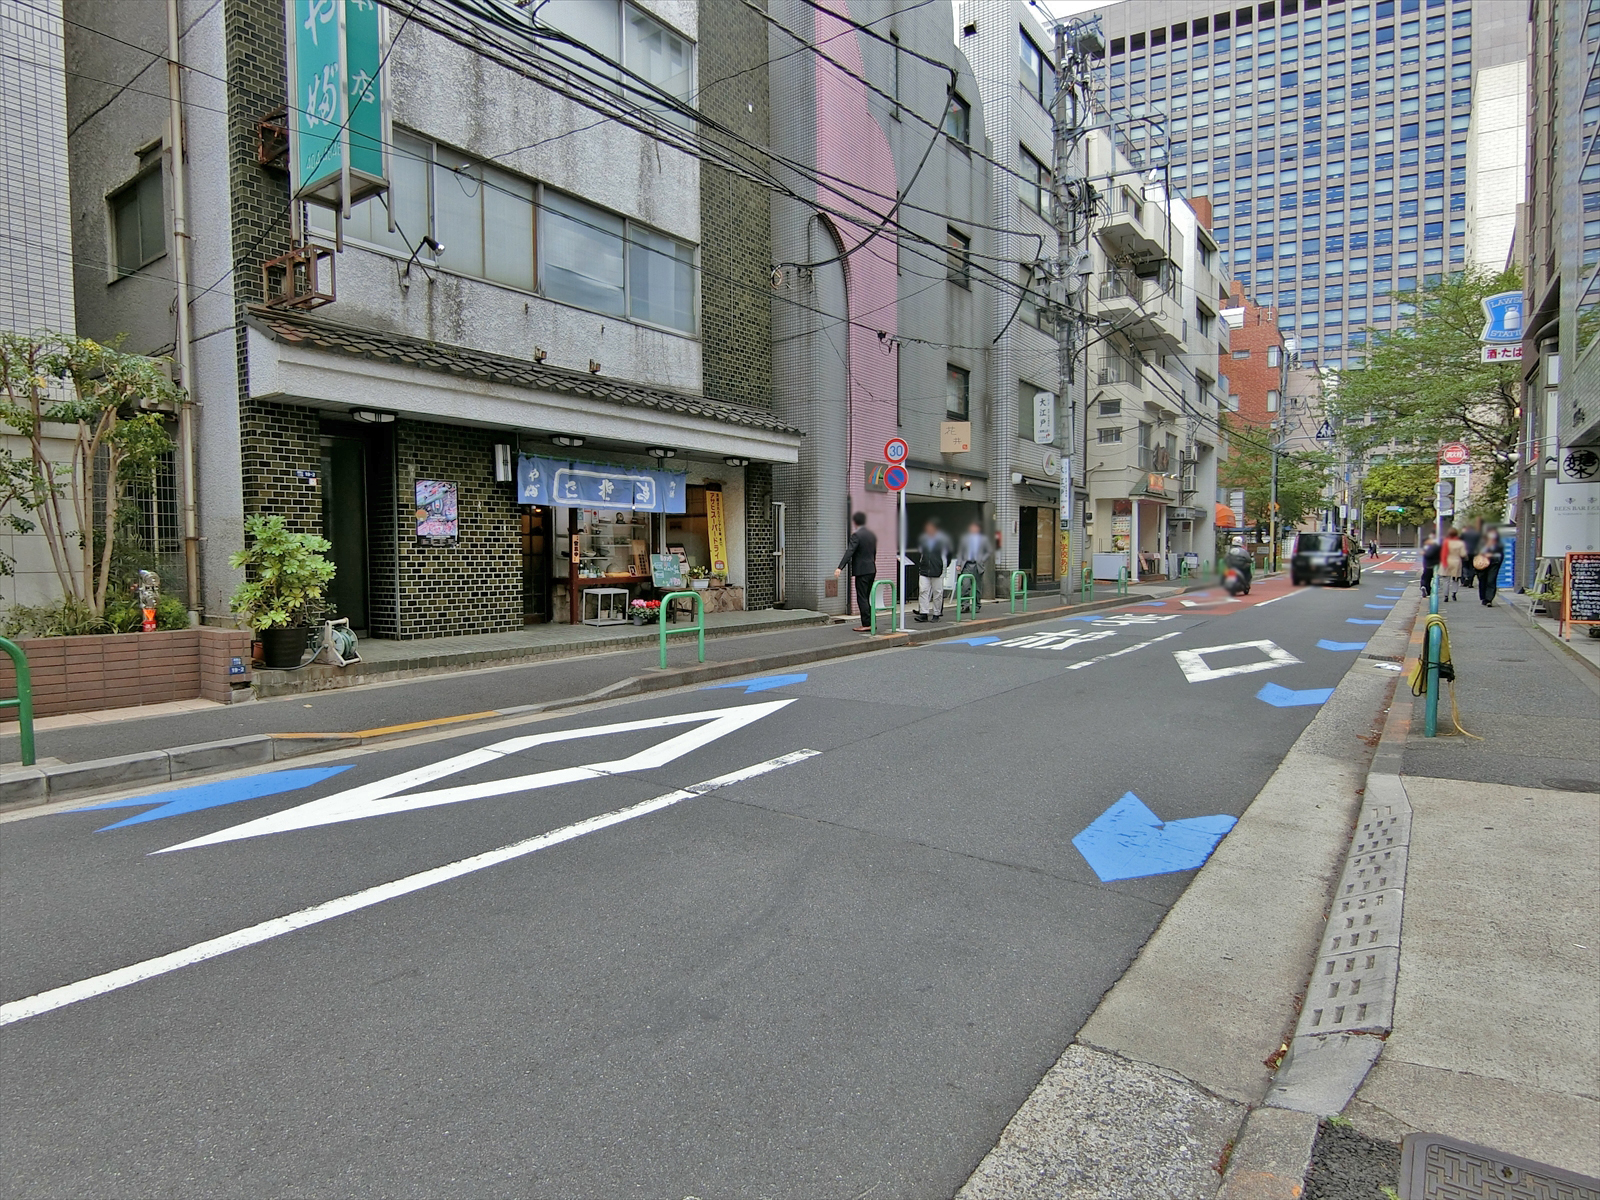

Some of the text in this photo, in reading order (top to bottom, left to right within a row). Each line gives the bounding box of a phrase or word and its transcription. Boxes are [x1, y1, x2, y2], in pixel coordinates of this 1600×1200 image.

[1039, 398, 1047, 427] 大江戸
[889, 445, 903, 457] 30
[709, 492, 720, 560] アサヒスーパードライ
